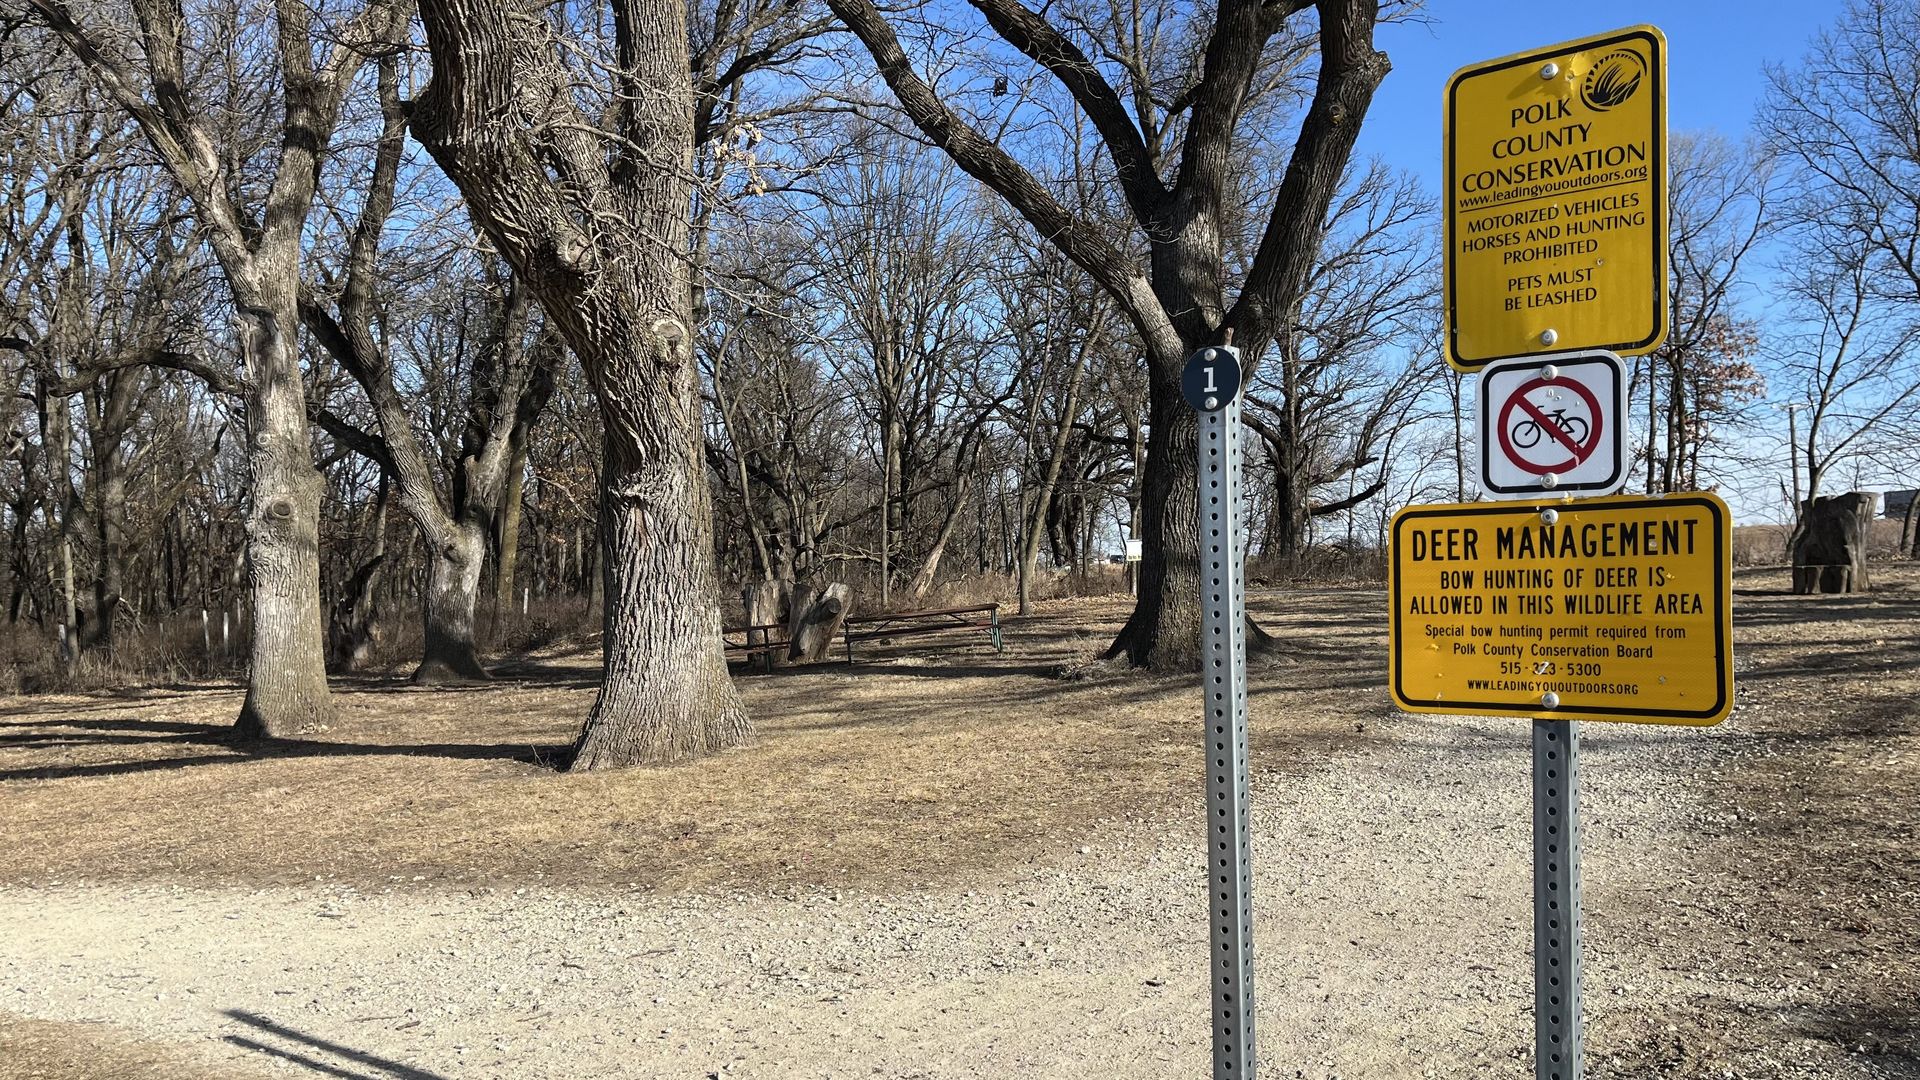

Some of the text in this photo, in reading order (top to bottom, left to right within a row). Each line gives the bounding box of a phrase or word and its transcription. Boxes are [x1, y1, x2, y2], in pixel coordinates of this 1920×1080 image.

[1511, 98, 1572, 128] POLK
[1492, 122, 1592, 159] COUNTY
[1462, 141, 1645, 193] CONSERVATION
[1459, 165, 1648, 208] www.leadingyououtdoors.org
[1467, 193, 1640, 234] MOTORIZED VEHICLES
[1462, 211, 1645, 253] HORSES AND HUNTING
[1503, 238, 1598, 265] PROHIBITED
[1508, 267, 1594, 292] PETS MUST
[1505, 287, 1597, 311] BE LEASHED
[1203, 367, 1217, 392] 1
[1412, 519, 1698, 562] DEER MANAGEMENT
[1440, 566, 1666, 590] BOW HUNTING OF DEER IS
[1410, 593, 1703, 615] ALLOWED IN THIS WILDLIFE AREA
[1425, 624, 1686, 641] Special bow hunting permit required from
[1453, 642, 1653, 659] Polk County Conservation Board
[1467, 679, 1639, 695] WWW.LEADINGYOUOUTDOORS.ORG
